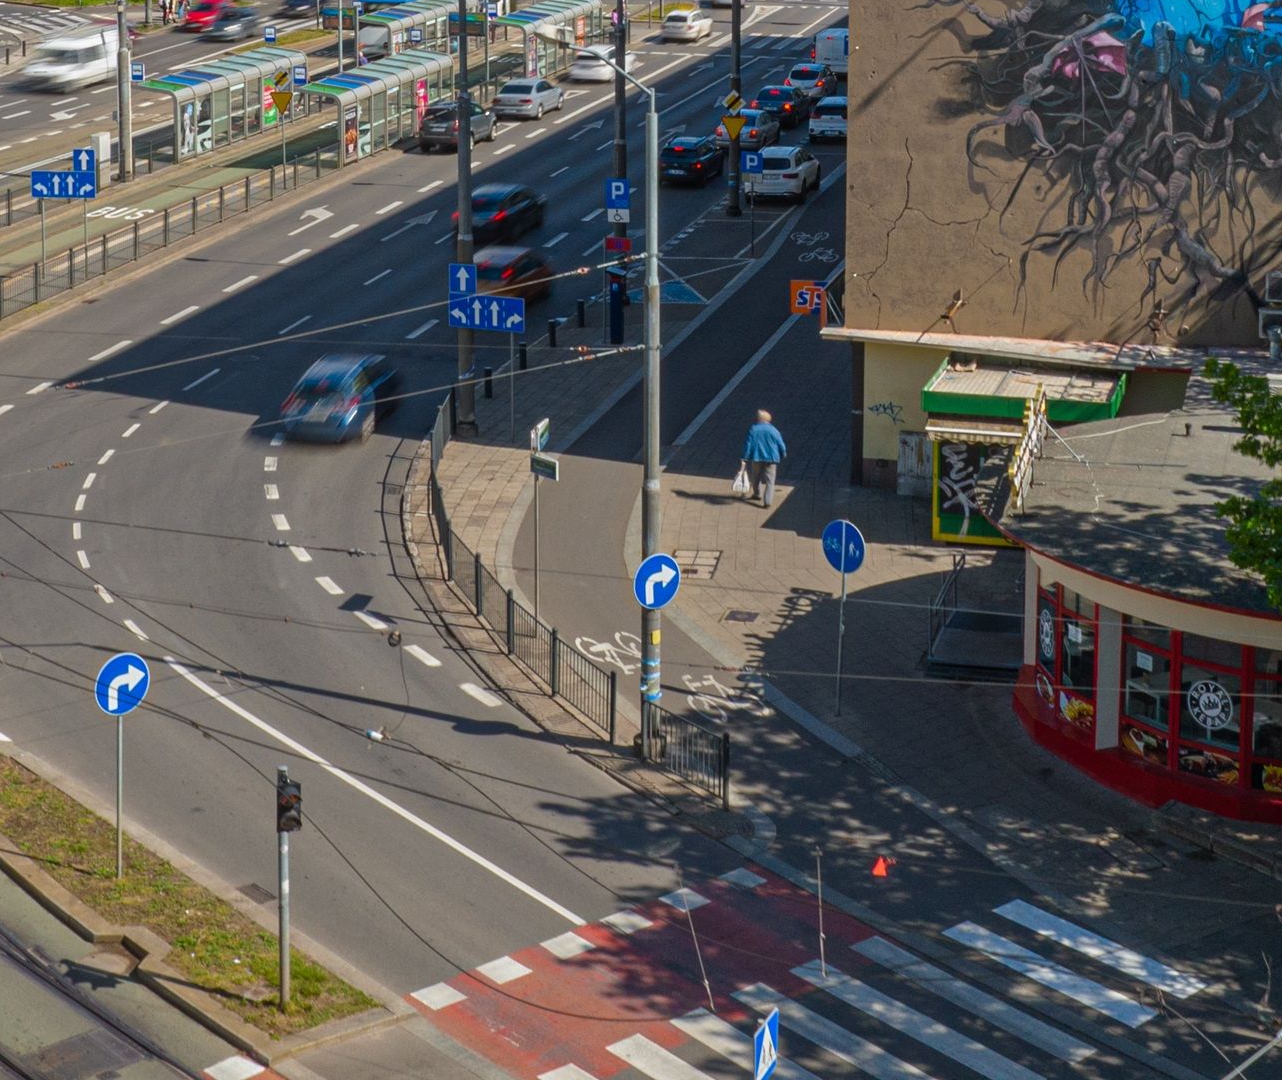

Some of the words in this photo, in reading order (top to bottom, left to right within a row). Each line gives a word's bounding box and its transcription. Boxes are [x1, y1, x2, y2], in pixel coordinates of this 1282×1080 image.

[746, 155, 758, 170] P
[611, 181, 625, 200] P
[86, 206, 155, 220] BUS
